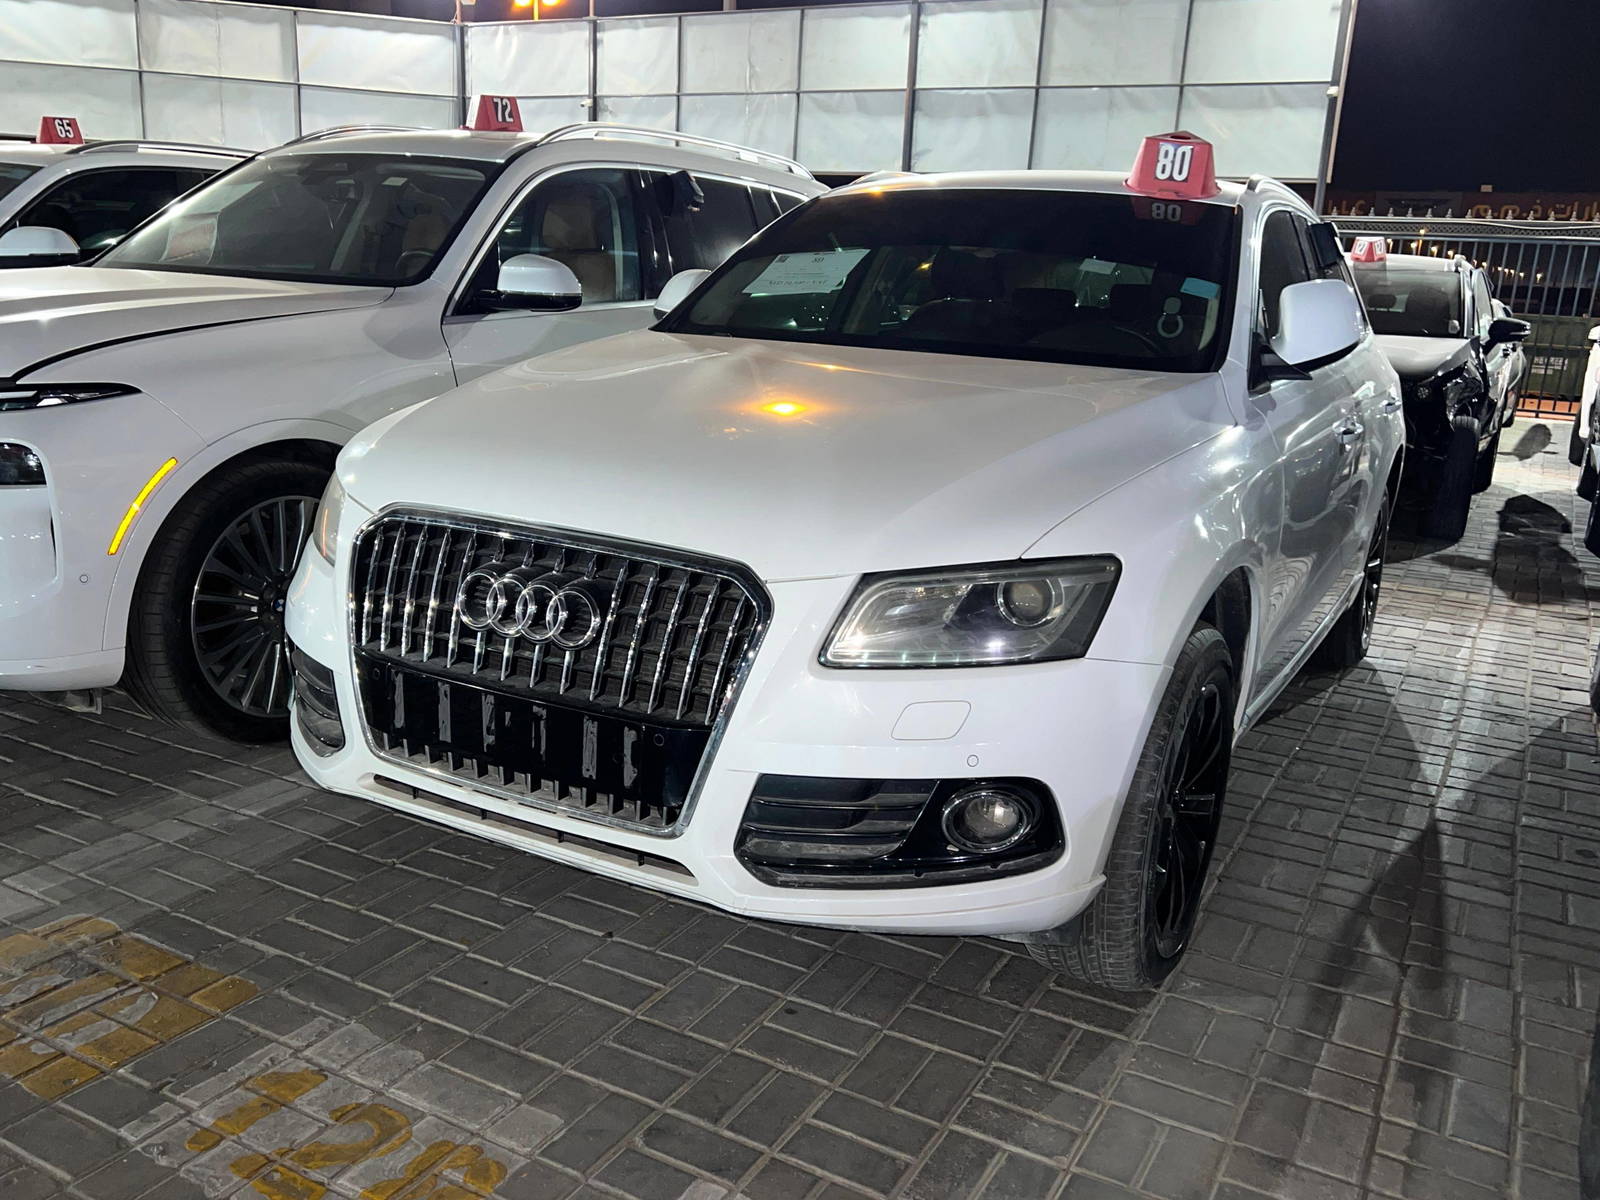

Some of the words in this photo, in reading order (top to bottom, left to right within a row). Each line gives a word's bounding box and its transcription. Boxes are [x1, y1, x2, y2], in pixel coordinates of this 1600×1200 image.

[493, 97, 514, 123] 72
[54, 119, 74, 138] 65
[1155, 141, 1194, 181] 80
